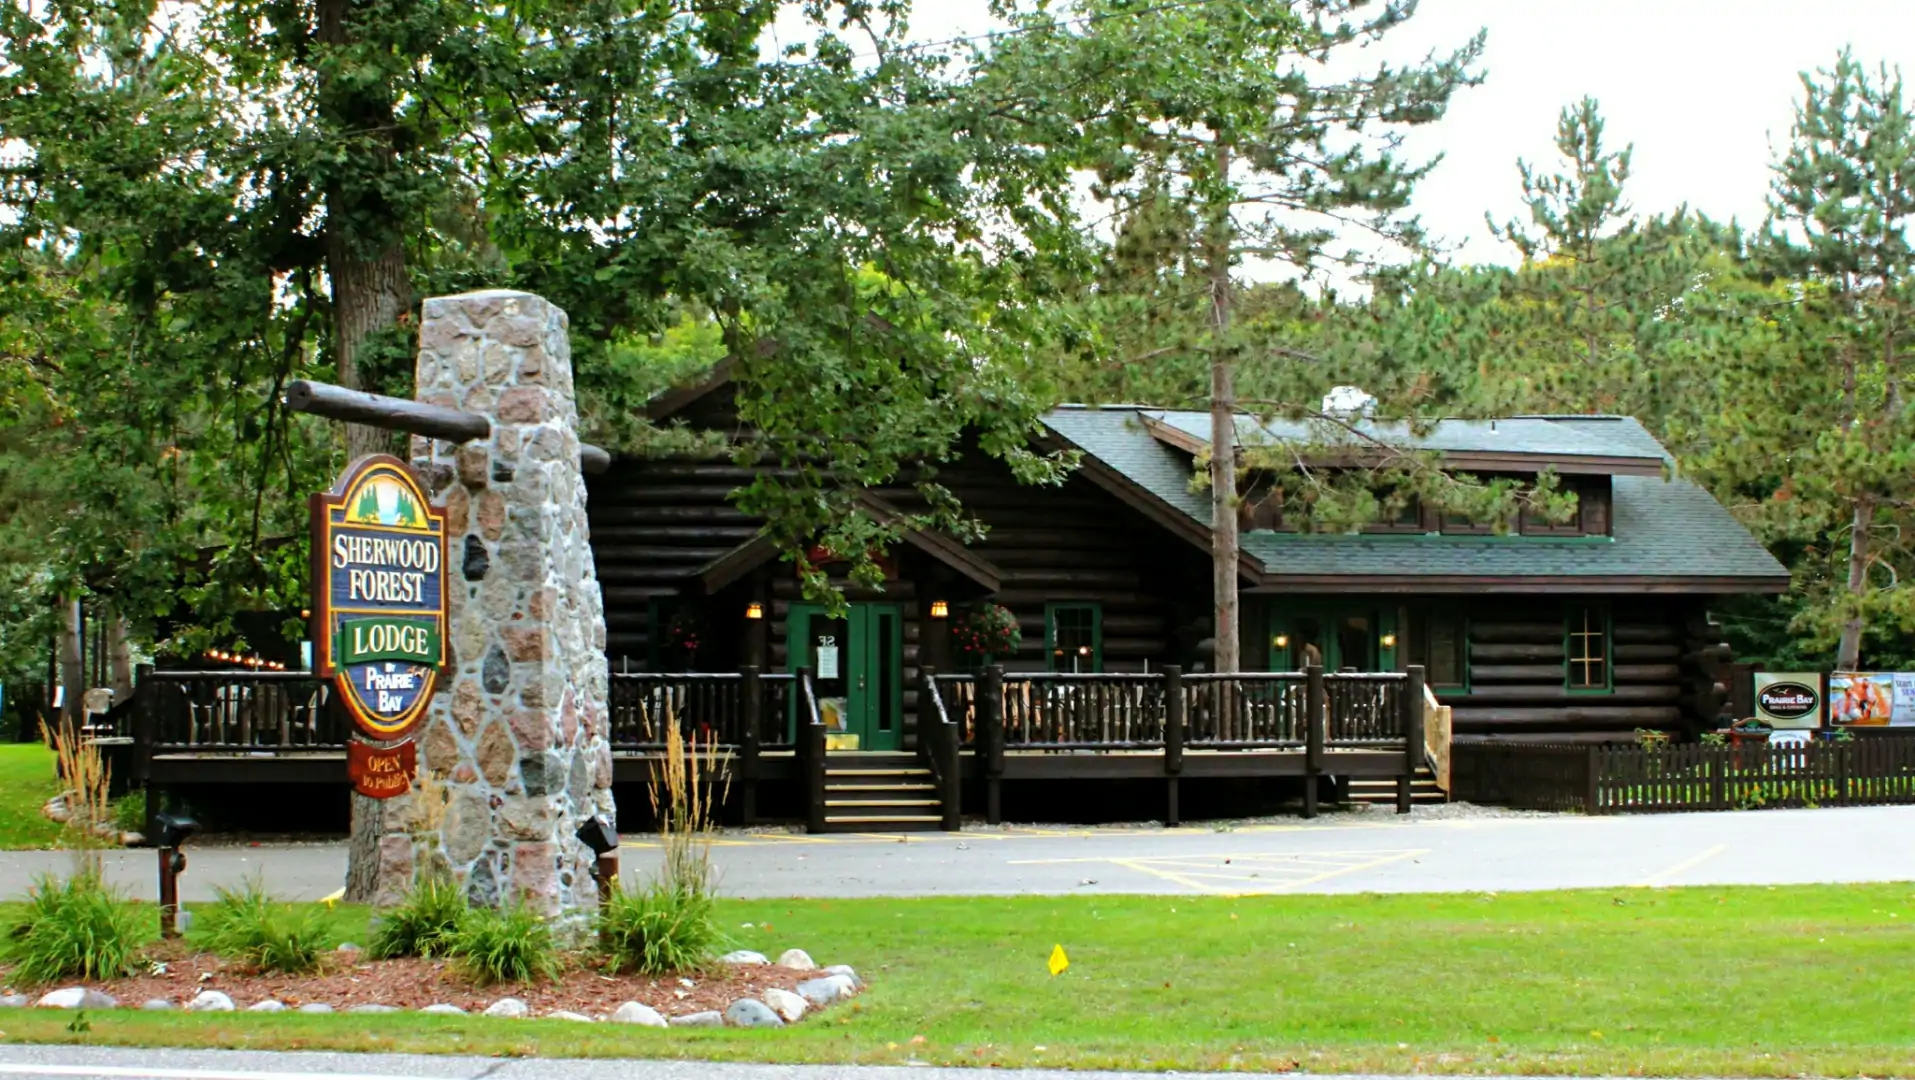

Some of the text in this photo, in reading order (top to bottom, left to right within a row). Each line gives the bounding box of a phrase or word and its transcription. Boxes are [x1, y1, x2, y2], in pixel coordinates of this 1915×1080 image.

[334, 534, 439, 573] SHERWOOD
[349, 568, 425, 603] FOREST
[354, 624, 429, 655] LODGE
[366, 666, 414, 690] PRAIRIE
[379, 690, 403, 712] BAY
[1762, 694, 1814, 704] PRAIRIE BAY
[368, 754, 400, 772] OPEN
